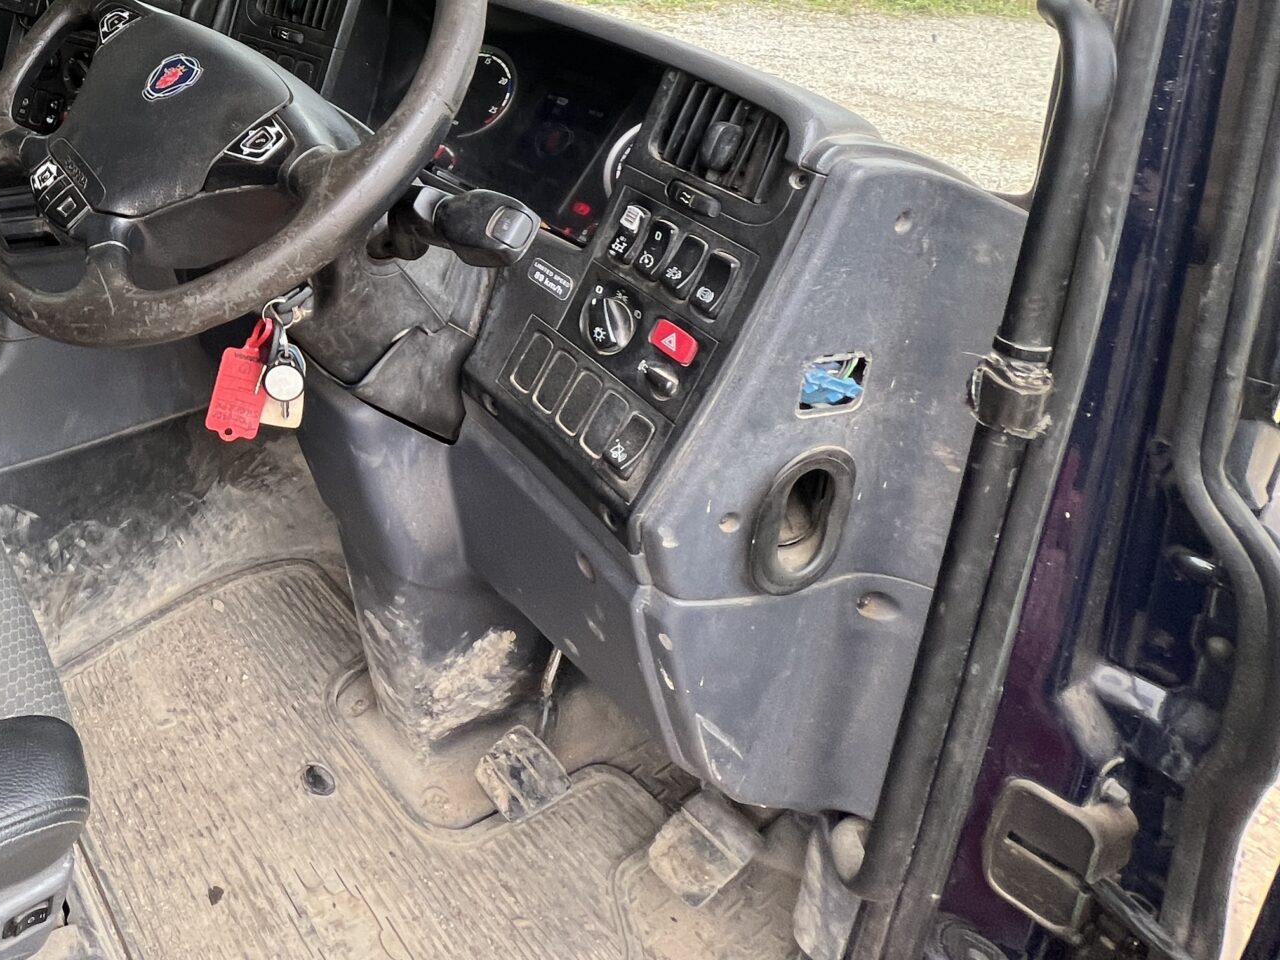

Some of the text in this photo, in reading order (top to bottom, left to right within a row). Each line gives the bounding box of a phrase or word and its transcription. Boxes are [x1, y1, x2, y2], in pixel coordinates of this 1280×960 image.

[533, 261, 571, 288] LIMITED SPEED
[533, 271, 563, 295] 89 km/h
